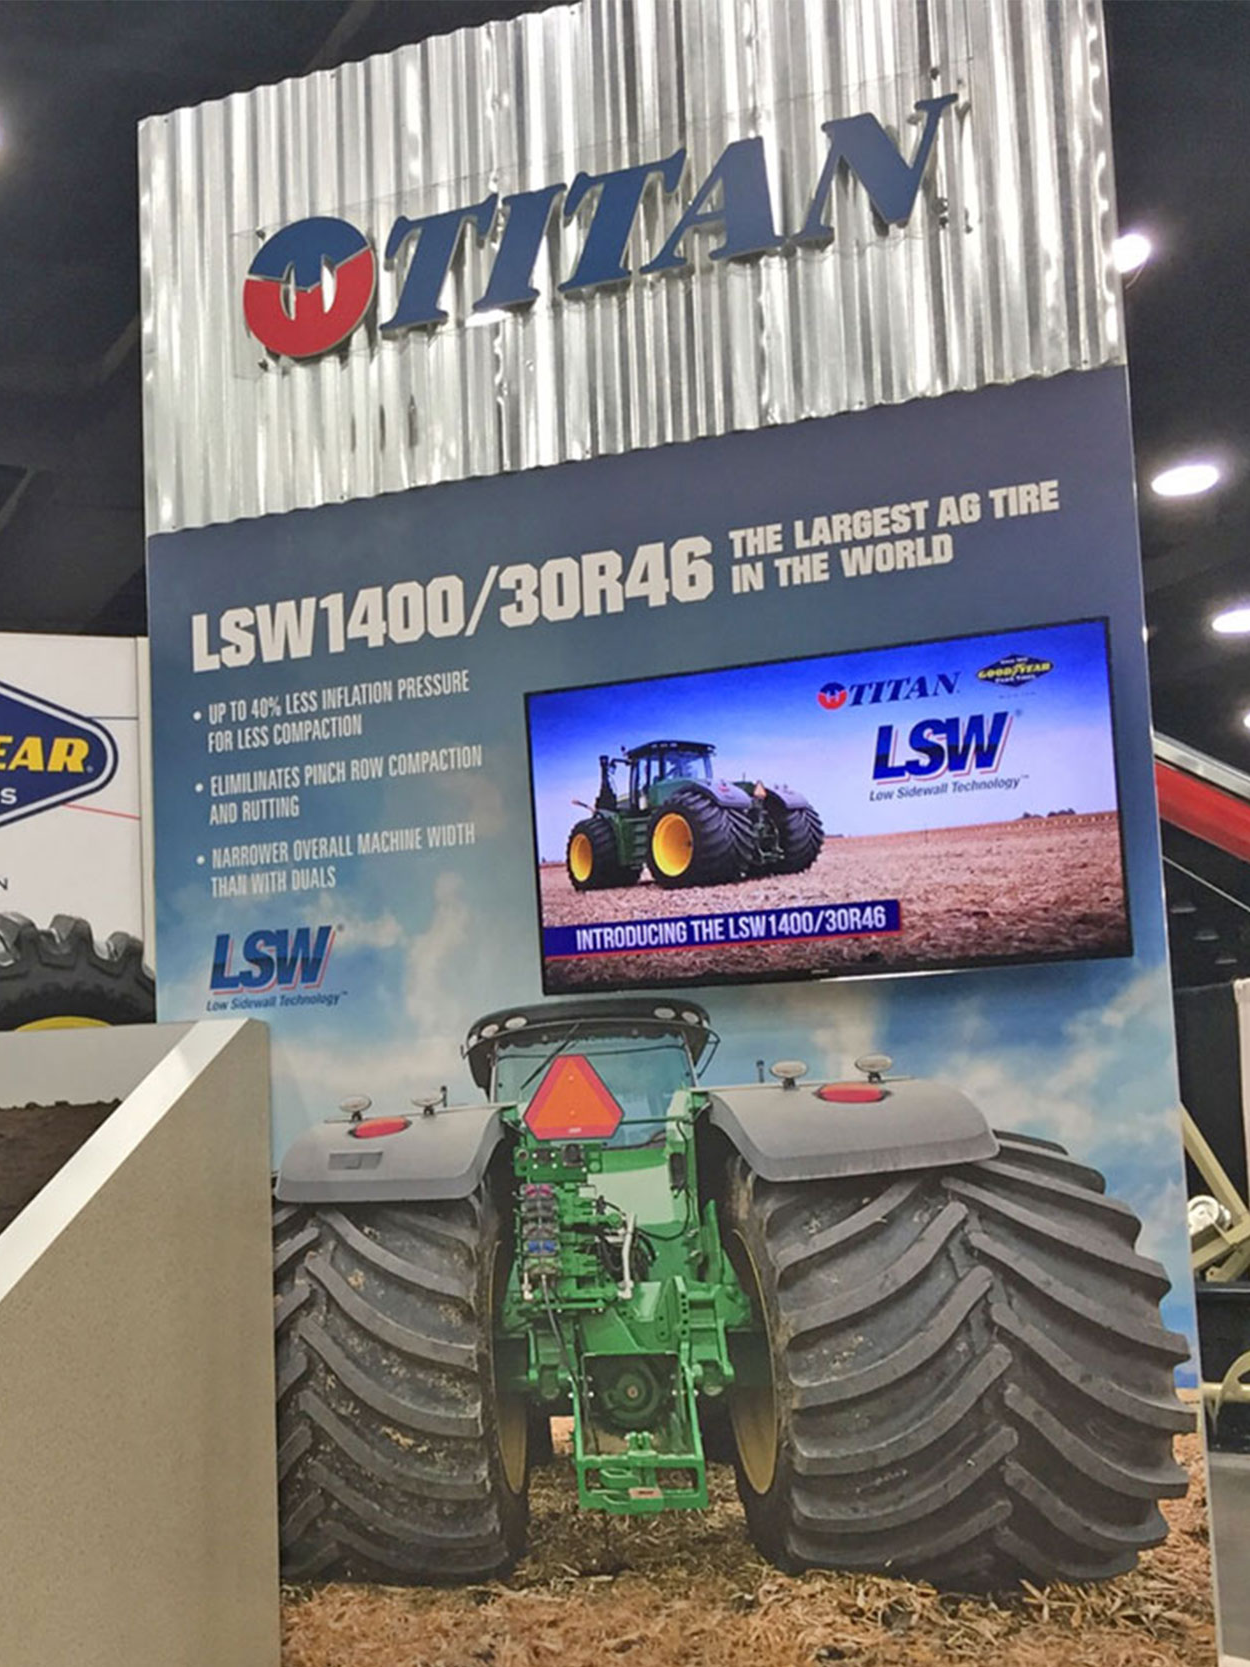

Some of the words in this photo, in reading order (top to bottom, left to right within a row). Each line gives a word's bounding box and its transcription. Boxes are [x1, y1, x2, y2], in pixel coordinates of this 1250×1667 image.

[379, 93, 958, 331] TITAN
[729, 523, 783, 559] THE
[794, 501, 929, 549] LARGEST
[937, 492, 982, 527] AG
[989, 480, 1059, 519] TIRE
[731, 561, 765, 594] IN
[774, 552, 830, 587] THE
[840, 533, 954, 578] WORLD
[192, 535, 713, 673] LSW1400/30R46
[208, 702, 227, 726] UP
[230, 699, 247, 723] TO
[251, 696, 282, 719] 40%
[286, 690, 319, 715] LESS
[322, 679, 393, 711] INFLATION
[397, 669, 470, 701] PRESSURE
[849, 672, 961, 707] TITAN
[208, 730, 234, 754] FOR
[237, 725, 270, 750] LESS
[273, 714, 363, 746] COMPACTION
[872, 711, 1012, 783] LSW
[304, 760, 346, 786] PINCH
[350, 756, 384, 781] ROW
[388, 744, 482, 777] COMPACTION
[209, 801, 238, 826] AND
[241, 795, 300, 823] RUTTING
[869, 789, 895, 802] Low
[897, 783, 948, 799] Sidewall
[952, 776, 1021, 793] Technology
[212, 841, 289, 869] NARROWER
[293, 834, 354, 861] OVERALL
[357, 827, 423, 855] MACHINE
[426, 822, 475, 848] WIDTH
[210, 873, 248, 898] THAN
[250, 869, 287, 895] WITH
[291, 865, 336, 891] DUALS
[576, 920, 687, 951] INTRODUCING
[690, 917, 724, 943] THE
[728, 905, 887, 941] LSW1400/30R46
[210, 924, 335, 993] LSW
